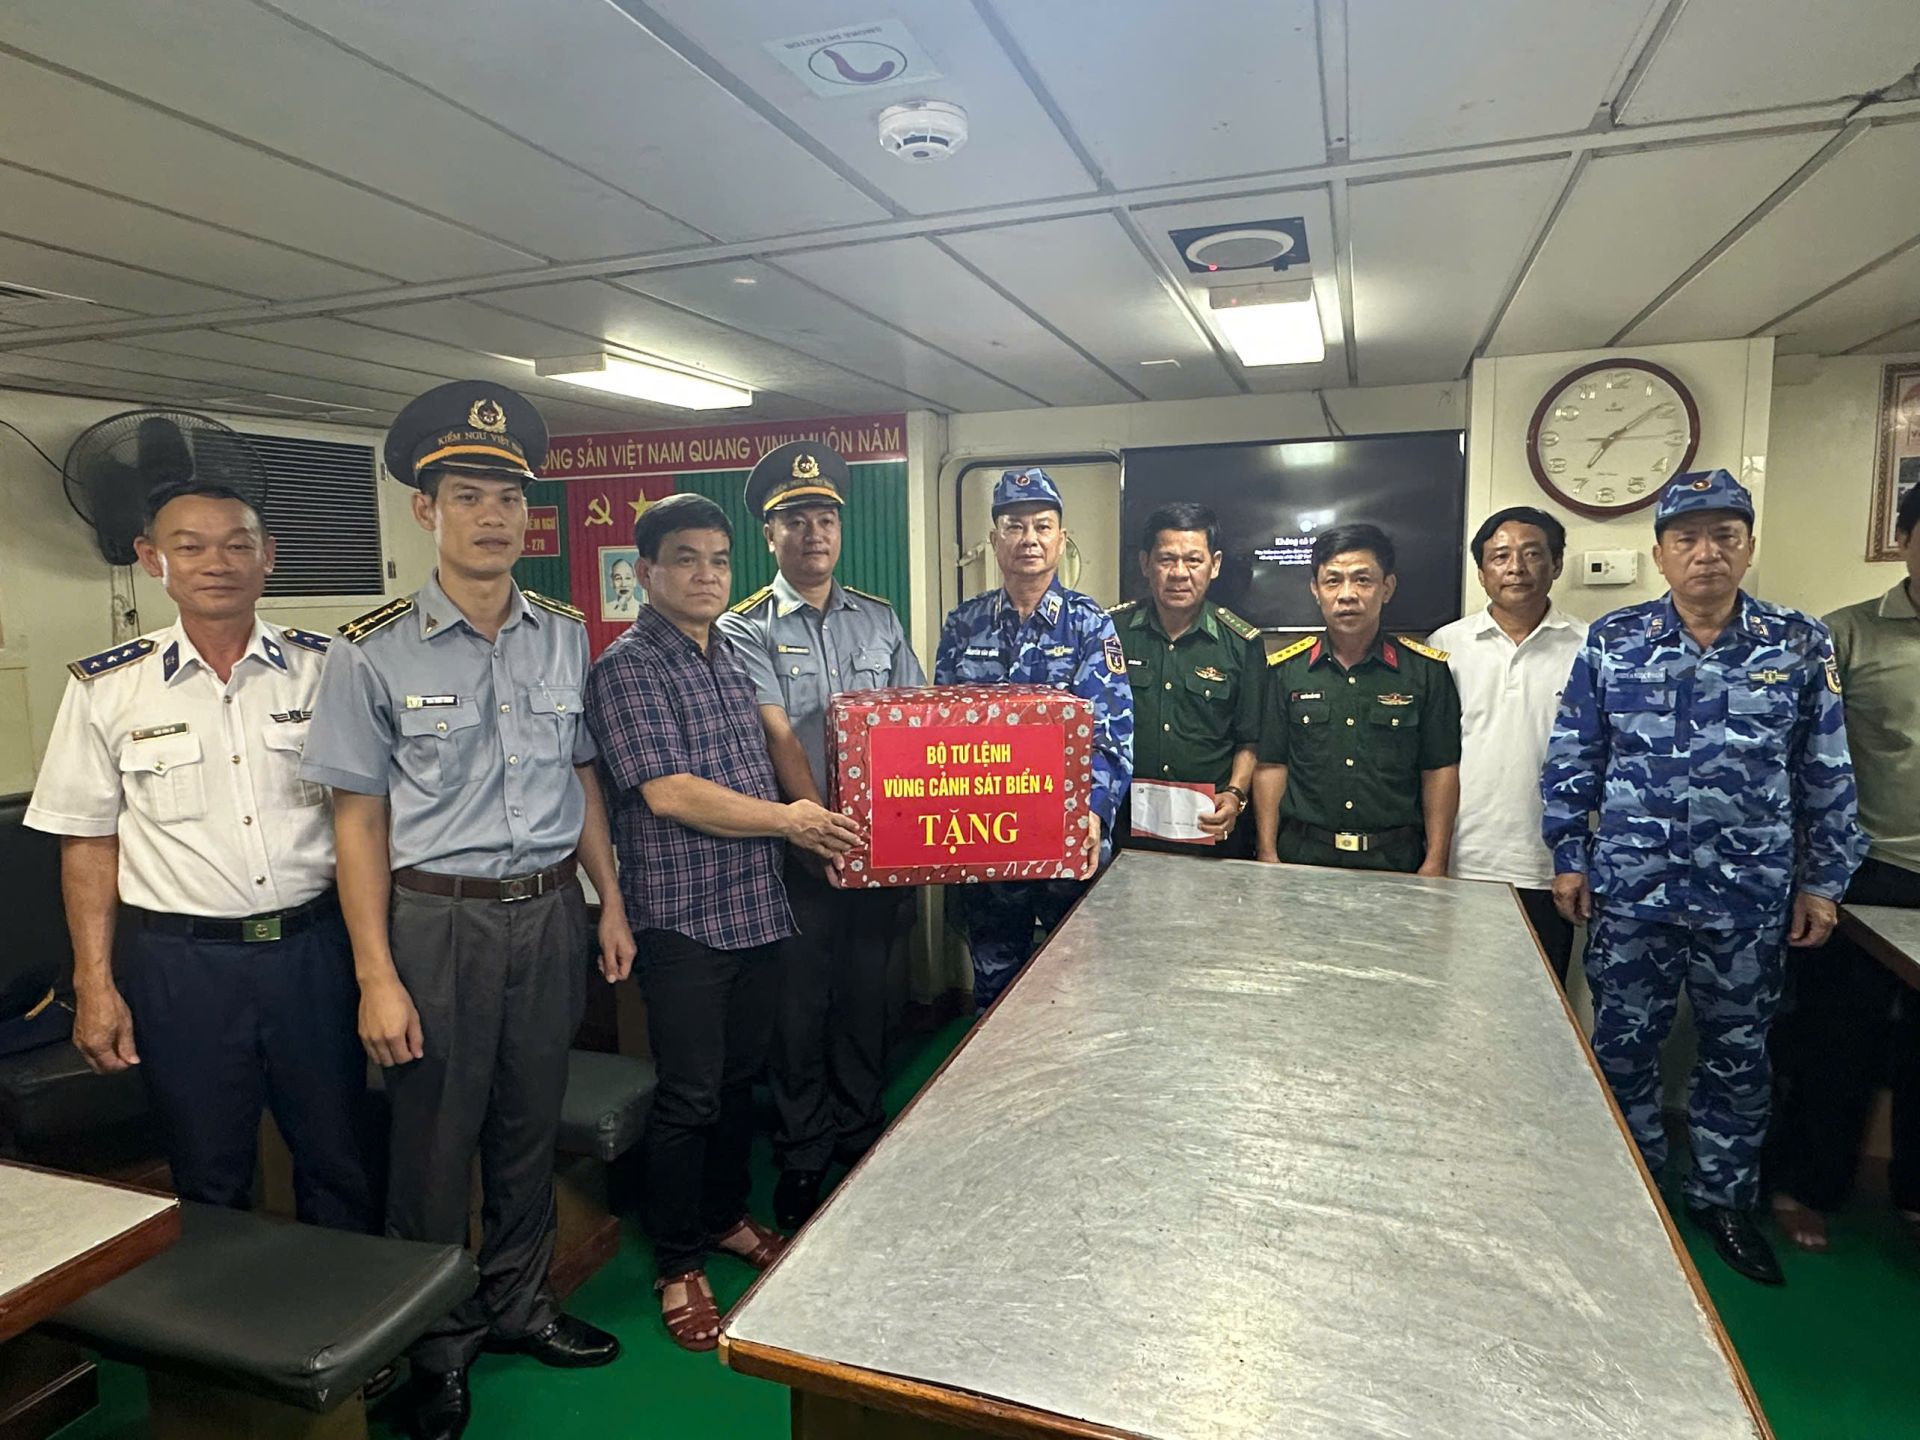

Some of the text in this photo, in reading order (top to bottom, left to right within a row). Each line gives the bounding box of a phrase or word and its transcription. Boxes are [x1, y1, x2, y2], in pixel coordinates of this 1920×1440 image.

[1605, 373, 1632, 390] 12
[577, 438, 608, 469] SẢN
[611, 438, 644, 471] VIỆT
[648, 440, 685, 465] NAM
[688, 436, 751, 463] QUANG
[858, 423, 900, 452] NĂM
[926, 740, 1011, 769] BỘ TƯ LỆNH
[883, 768, 1054, 798] VÙNG CẢNH SÁT BIỂN 4
[918, 808, 1020, 855] TẶNG
